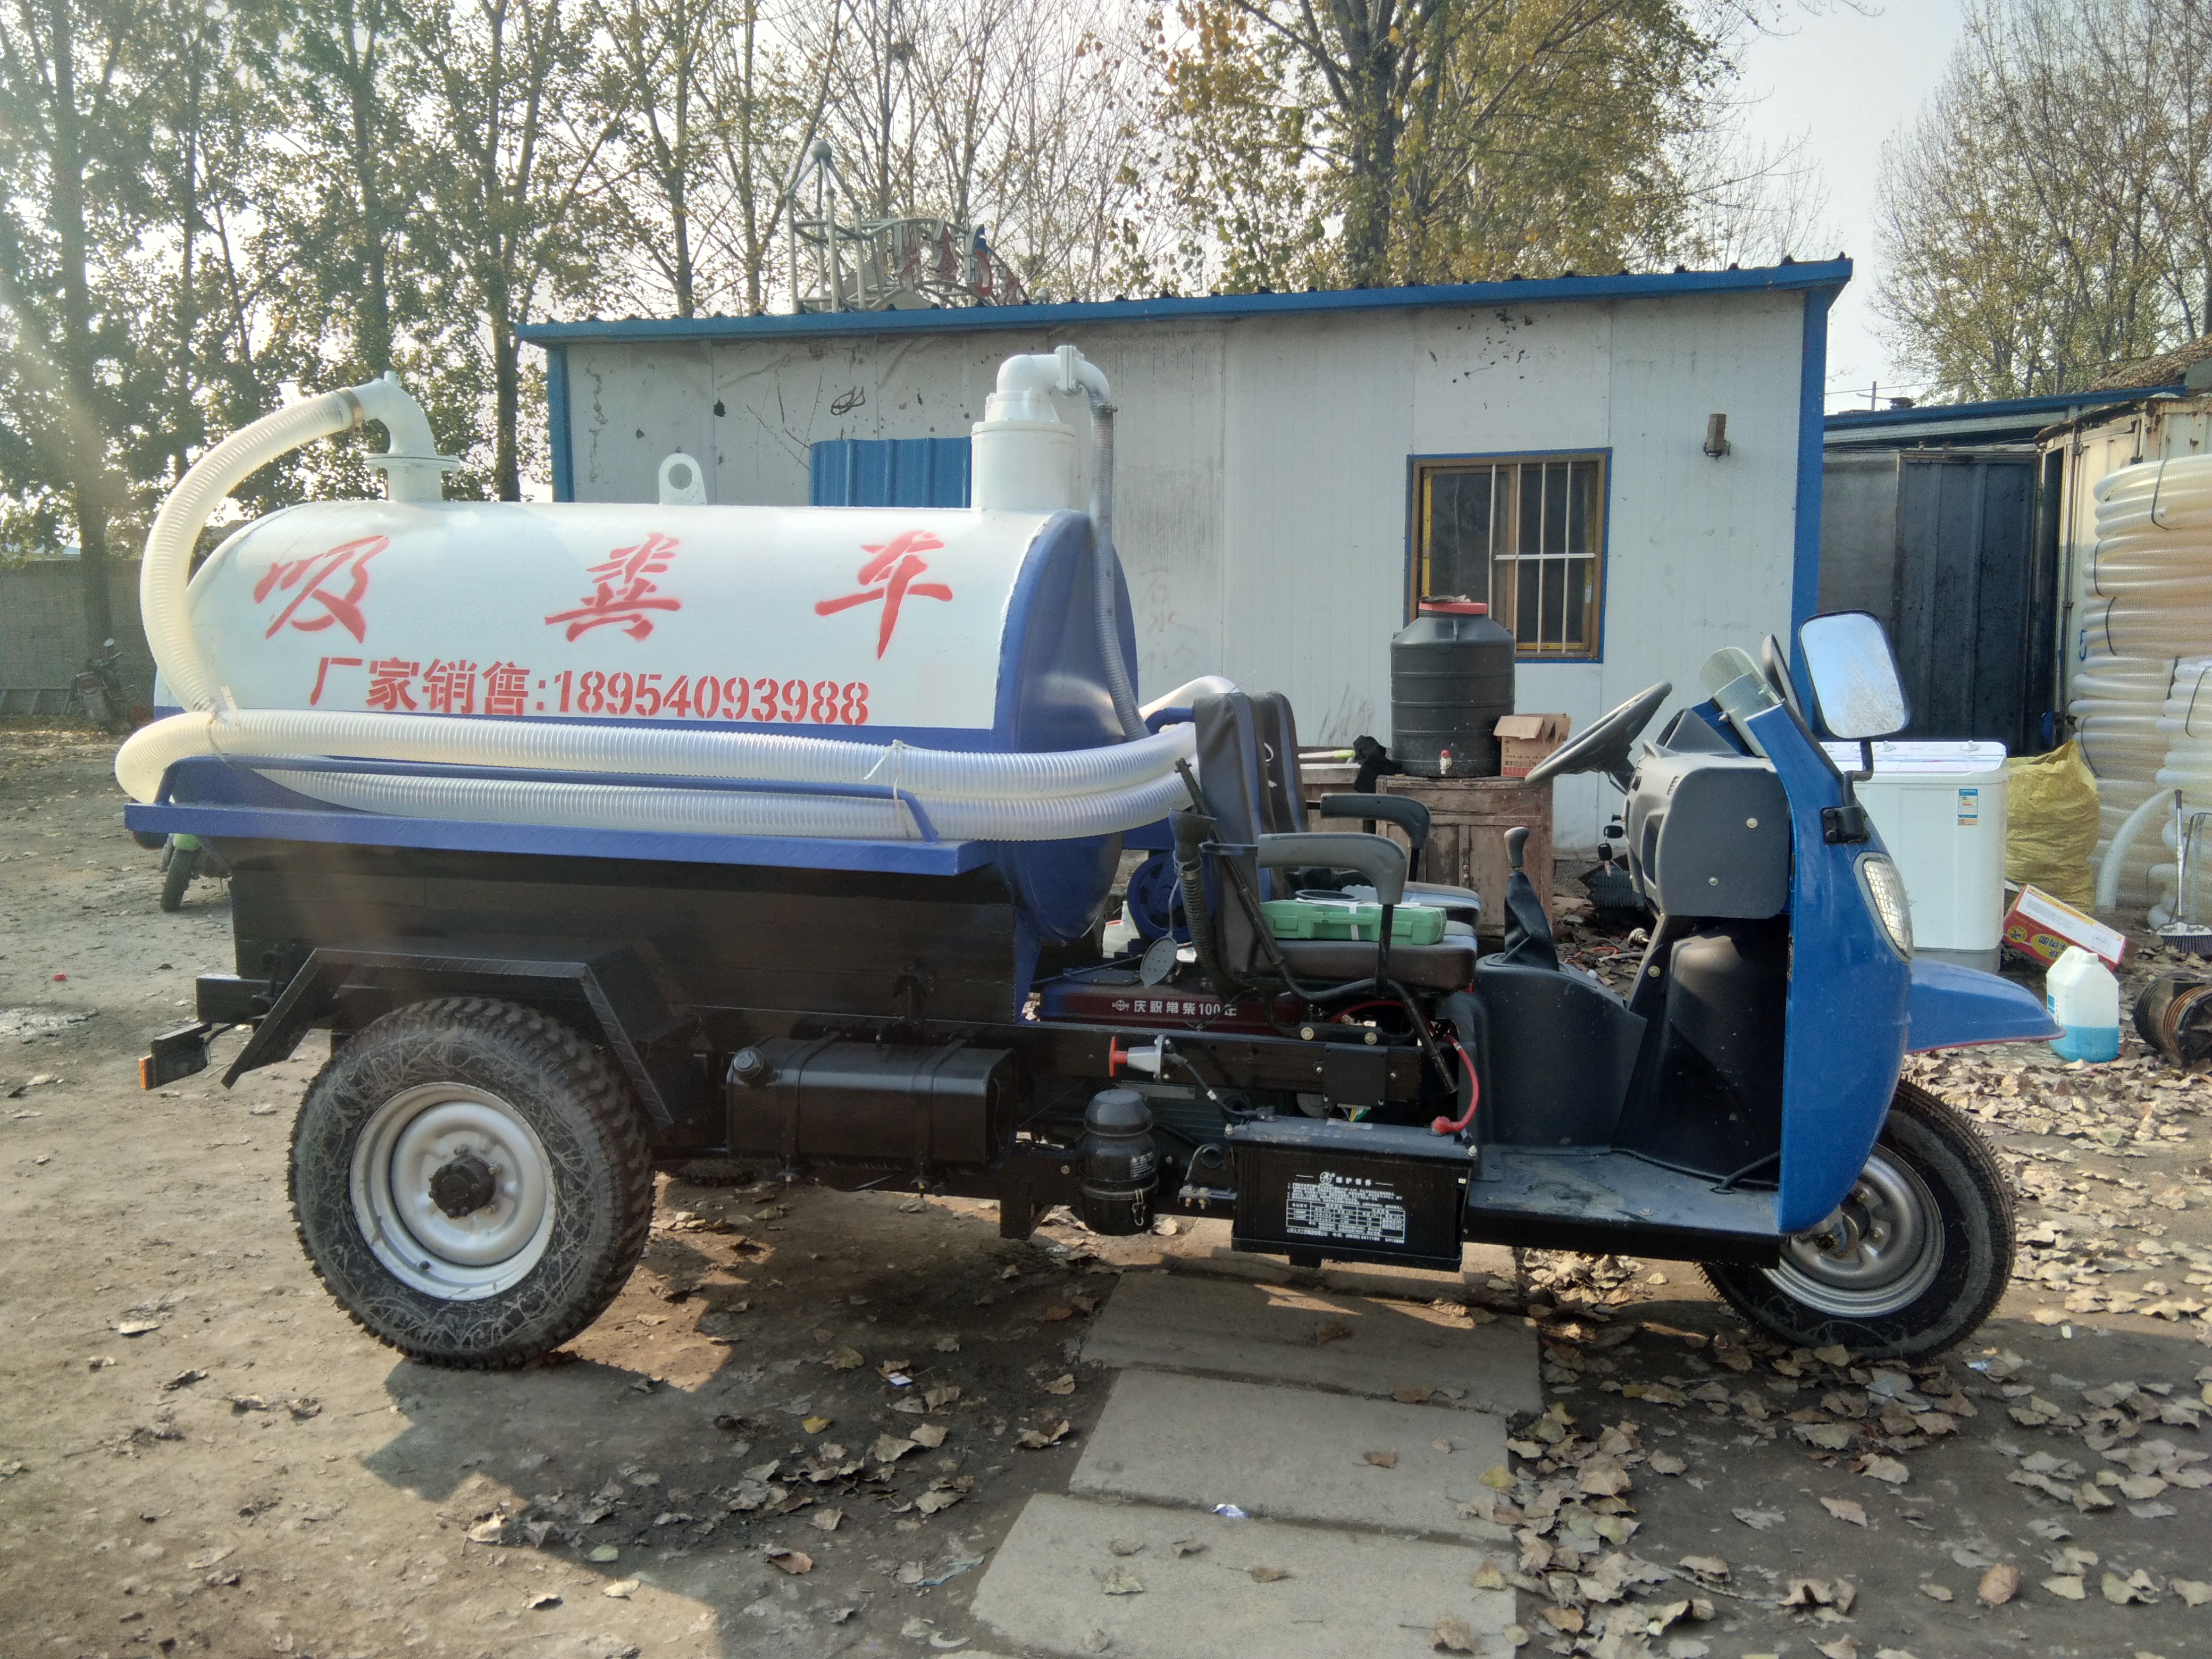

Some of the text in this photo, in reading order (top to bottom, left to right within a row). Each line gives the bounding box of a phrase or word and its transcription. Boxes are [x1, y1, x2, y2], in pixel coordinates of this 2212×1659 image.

[310, 657, 870, 725] 厂家销售:18954093988
[2039, 935, 2067, 951] 牛肉面
[1134, 1000, 1237, 1017] 庆祝常柴100年
